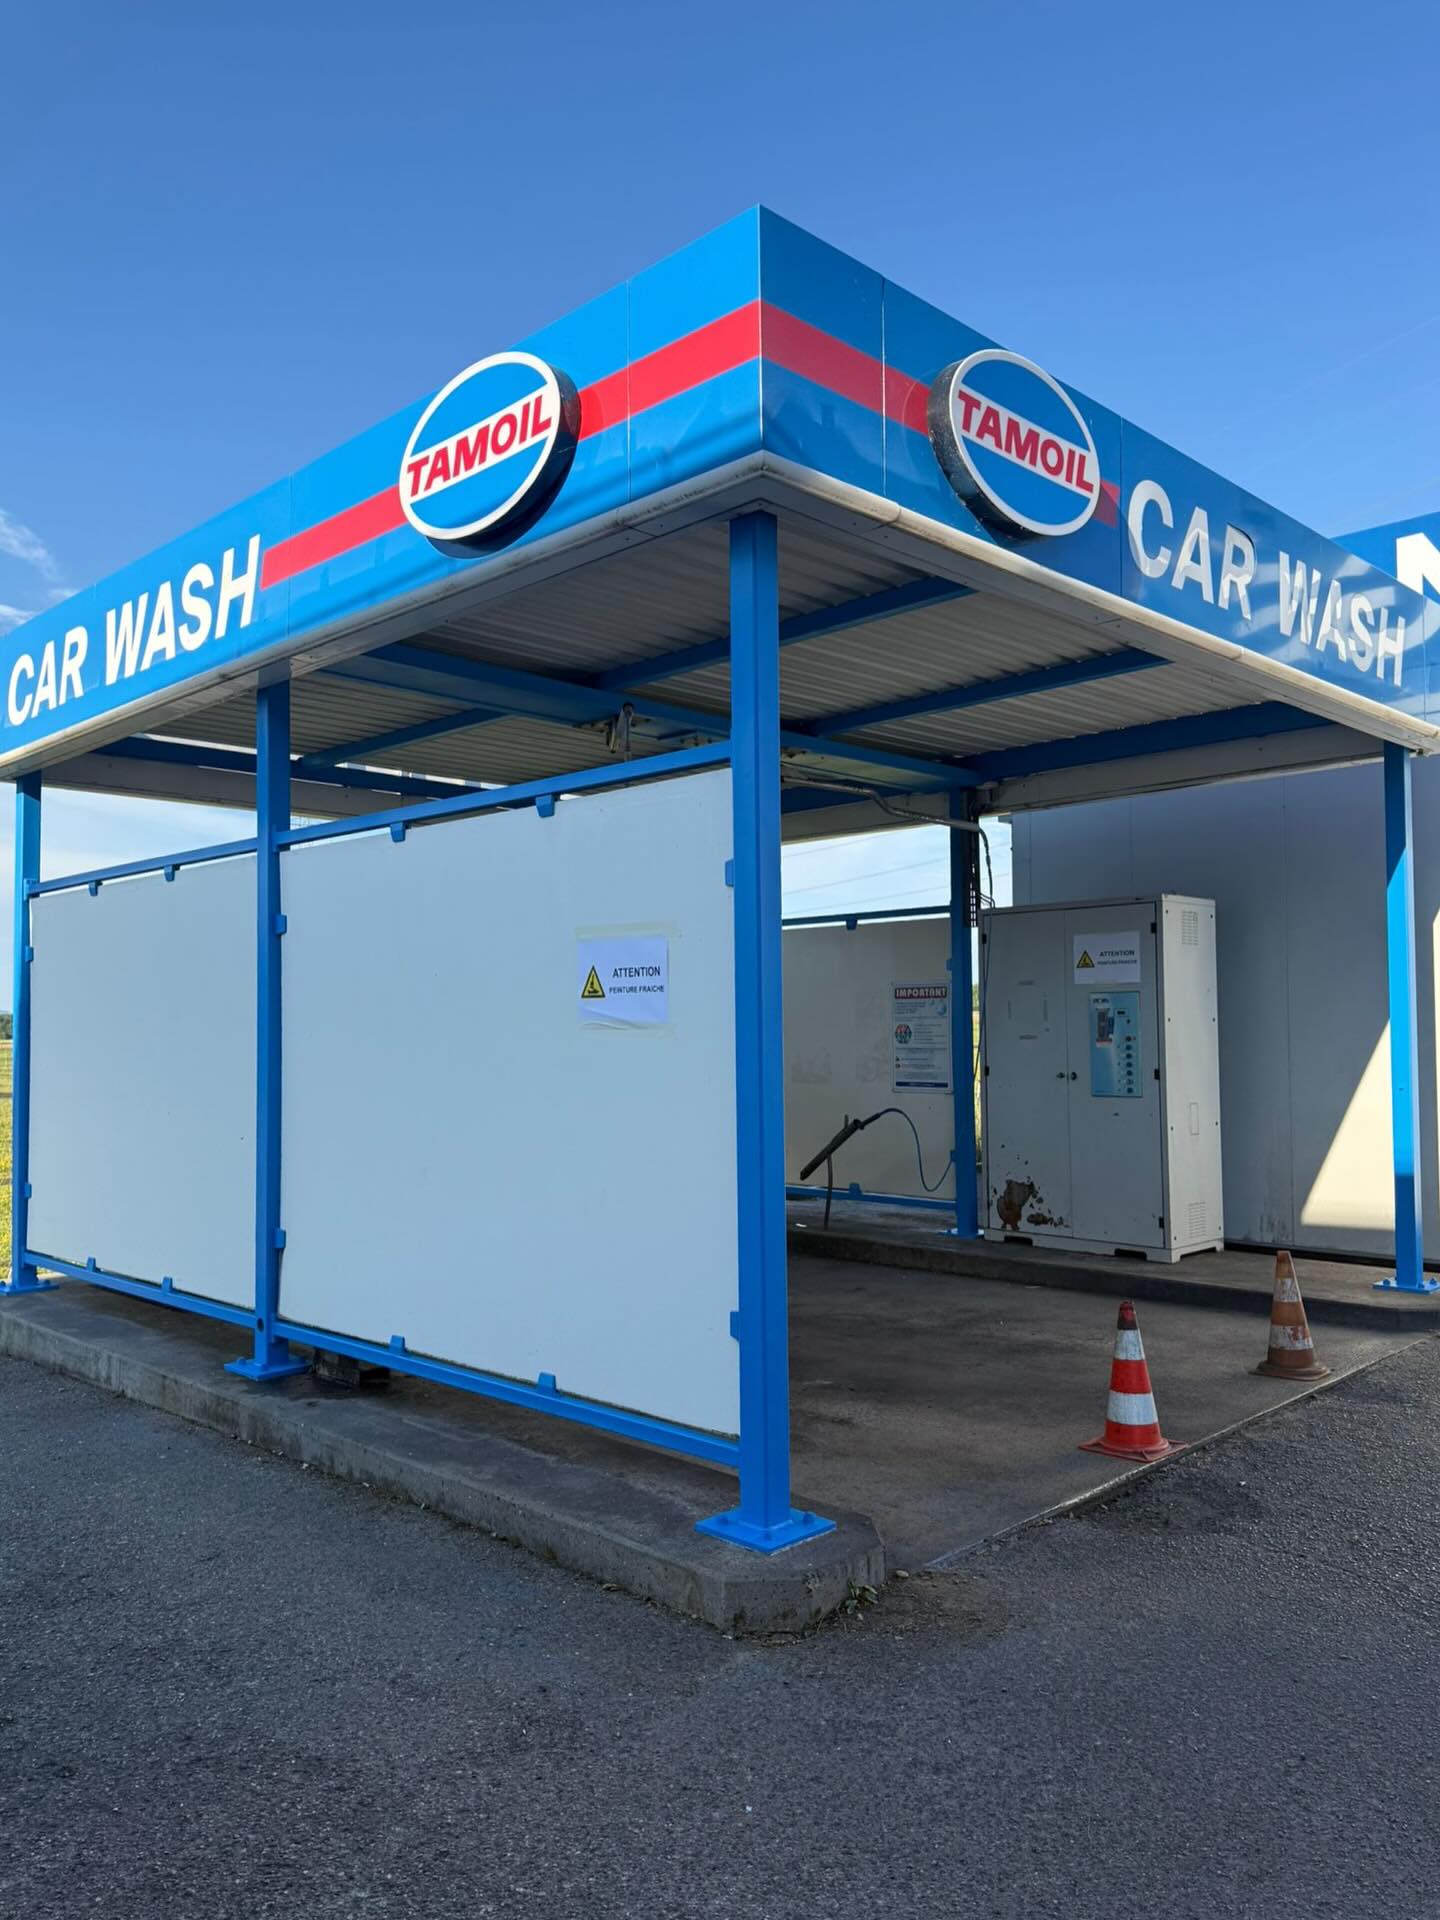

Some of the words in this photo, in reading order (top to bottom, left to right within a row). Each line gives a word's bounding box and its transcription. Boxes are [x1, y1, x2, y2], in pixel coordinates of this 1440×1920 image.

[407, 394, 552, 497] TAMOIL
[958, 389, 1094, 493] TAMOIL
[7, 625, 88, 726] CAR
[105, 533, 261, 686] WASH
[1128, 479, 1257, 620] CAR
[1279, 550, 1406, 687] WASH
[609, 986, 637, 994] PEINTURE
[612, 965, 661, 978] ATTENTION
[896, 988, 946, 997] IMPORTANT
